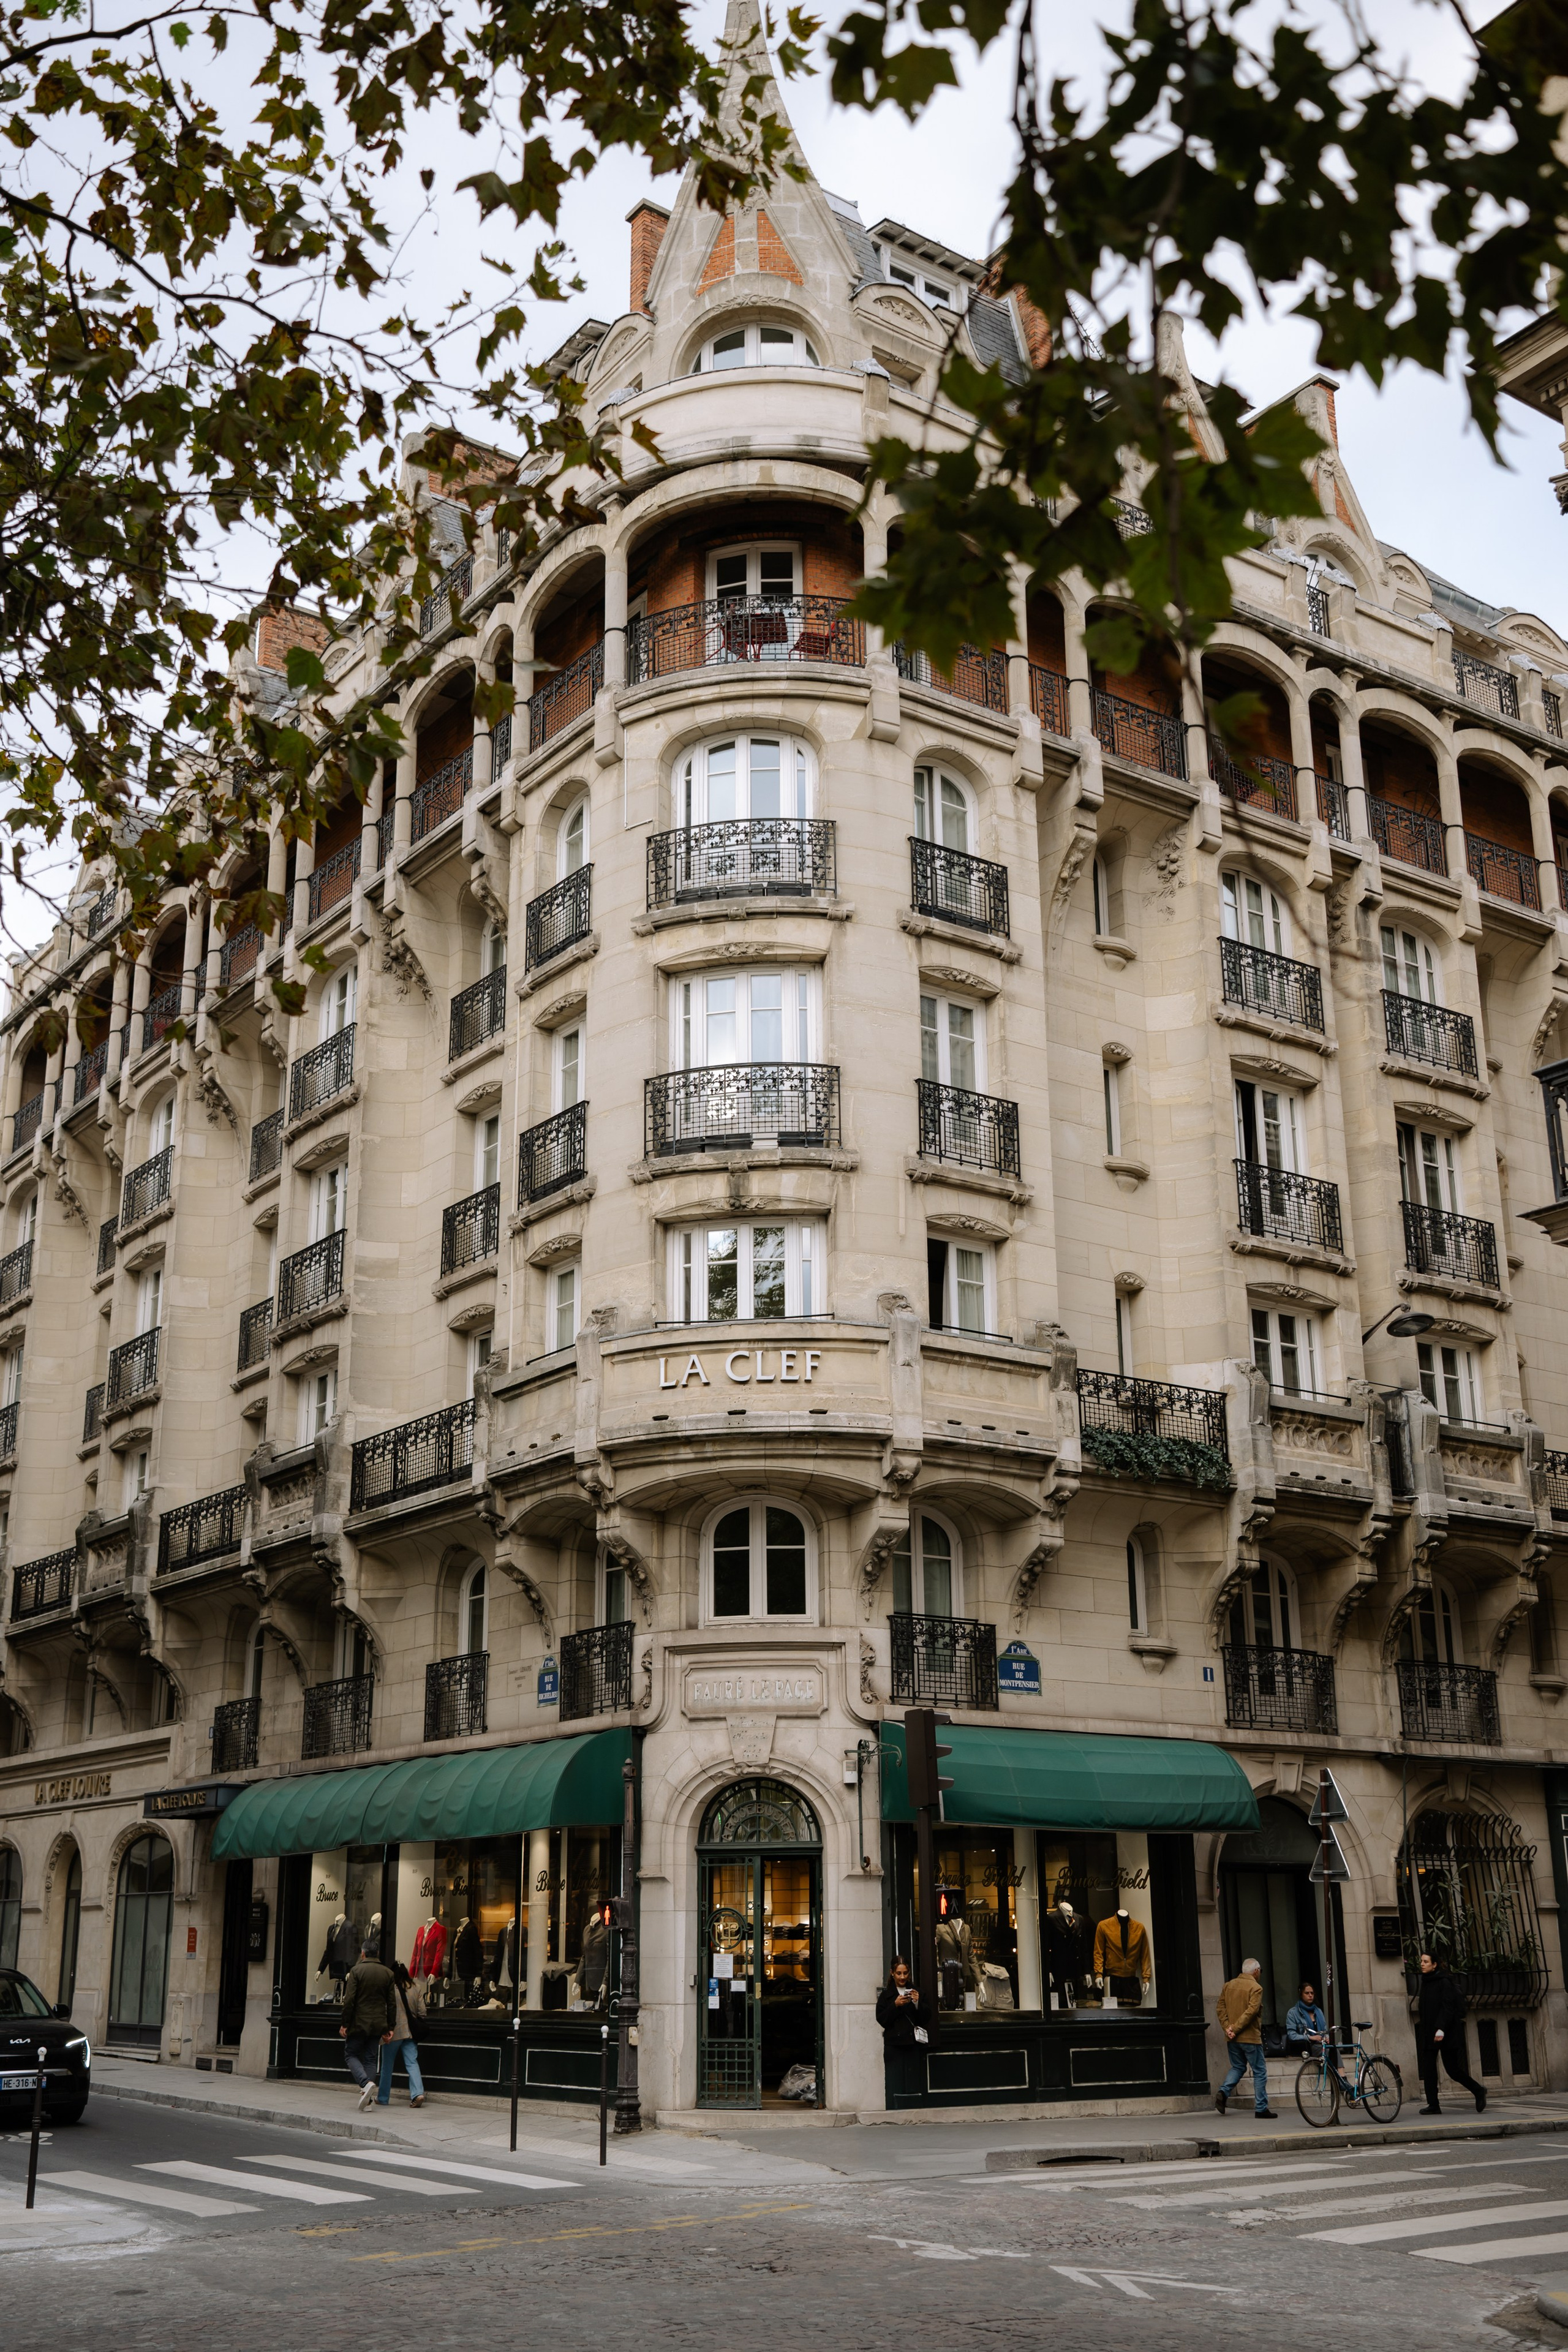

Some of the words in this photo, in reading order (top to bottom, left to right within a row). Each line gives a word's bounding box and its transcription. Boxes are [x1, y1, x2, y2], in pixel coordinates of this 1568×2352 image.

[658, 1354, 710, 1389] LA
[725, 1350, 821, 1383] CLEF
[693, 1676, 745, 1701] FAURÉ
[751, 1679, 770, 1700] LE
[775, 1679, 815, 1700] PAGE
[1000, 1679, 1039, 1688] MONTPENSIER
[539, 1691, 558, 1700] RICHELIEU
[34, 1783, 47, 1805] LA
[48, 1778, 72, 1803] CLEF
[72, 1773, 111, 1800] LOUVRE
[151, 1796, 162, 1811] LA
[162, 1795, 178, 1810] CLEF
[179, 1791, 206, 1807] LOUVRE
[722, 1802, 796, 1842] ARQUEBUSIER
[420, 1877, 447, 1898] Bruce
[535, 1869, 566, 1892] Bruce
[982, 1865, 1027, 1888] Field
[1057, 1866, 1101, 1889] Bruce
[1110, 1867, 1150, 1890] Field
[316, 1883, 339, 1902] Bruce
